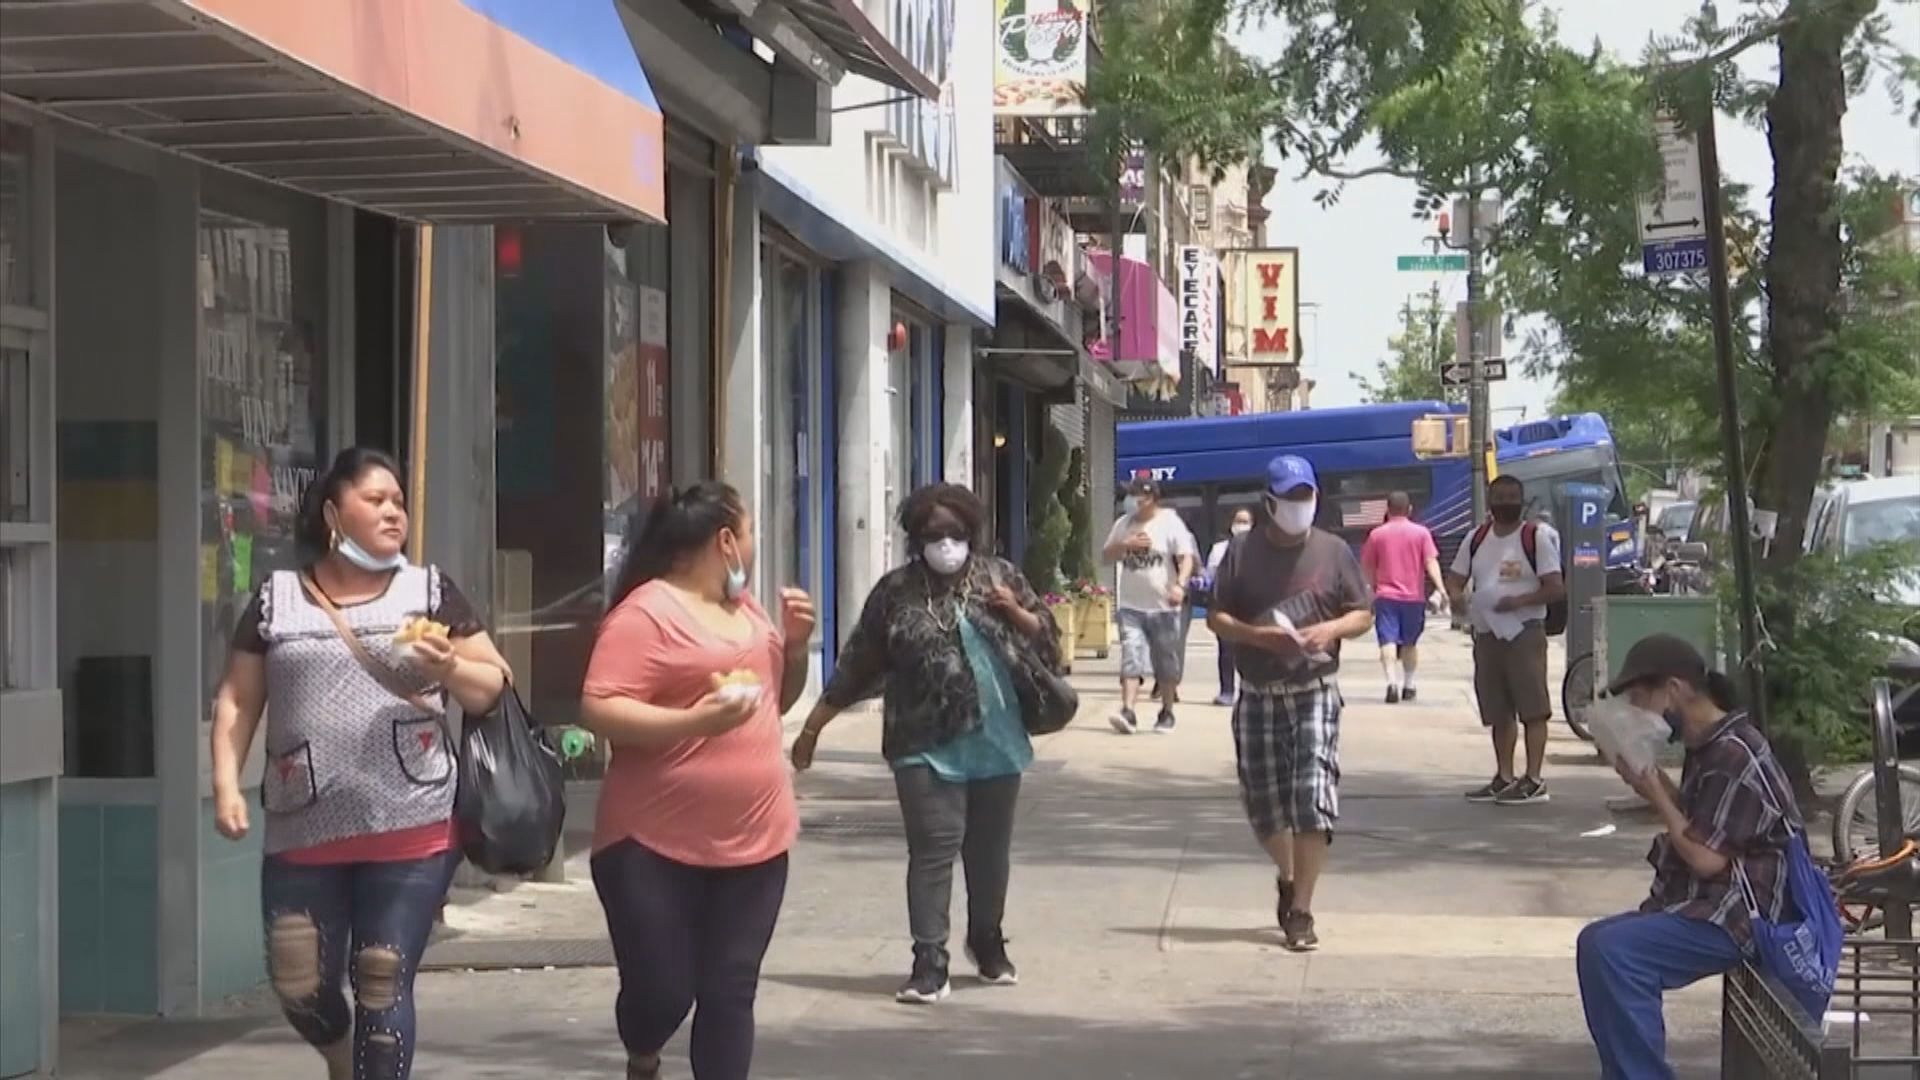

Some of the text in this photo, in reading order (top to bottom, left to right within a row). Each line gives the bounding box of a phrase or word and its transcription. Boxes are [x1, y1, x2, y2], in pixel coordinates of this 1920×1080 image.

[1655, 249, 1706, 271] 307375
[1183, 248, 1199, 350] EYECARE
[1252, 263, 1289, 353] VIM
[1150, 466, 1177, 481] NY
[1581, 501, 1598, 525] P
